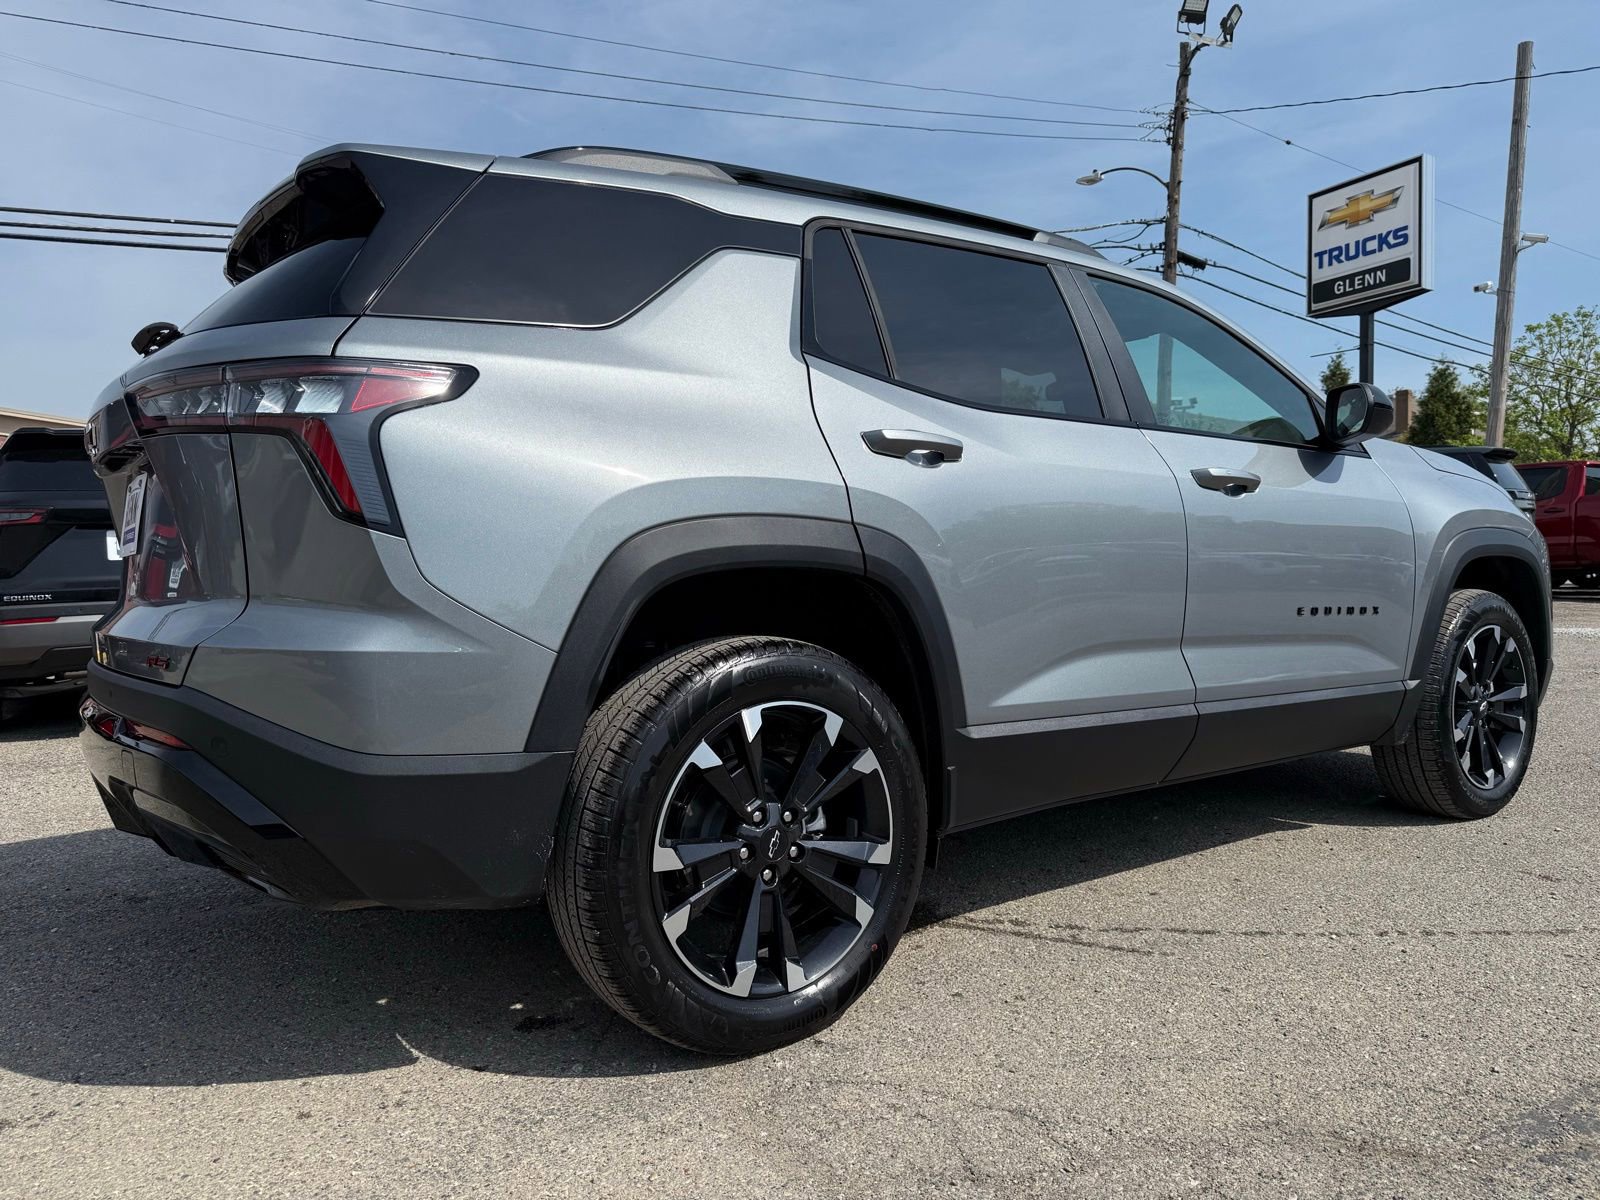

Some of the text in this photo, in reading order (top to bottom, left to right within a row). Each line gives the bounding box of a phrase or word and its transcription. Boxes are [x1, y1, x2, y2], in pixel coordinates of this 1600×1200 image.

[1314, 225, 1409, 269] TRUCKS
[1334, 269, 1387, 295] GLENN
[3, 594, 52, 602] EQUINOX
[1296, 606, 1379, 617] EQUINOX
